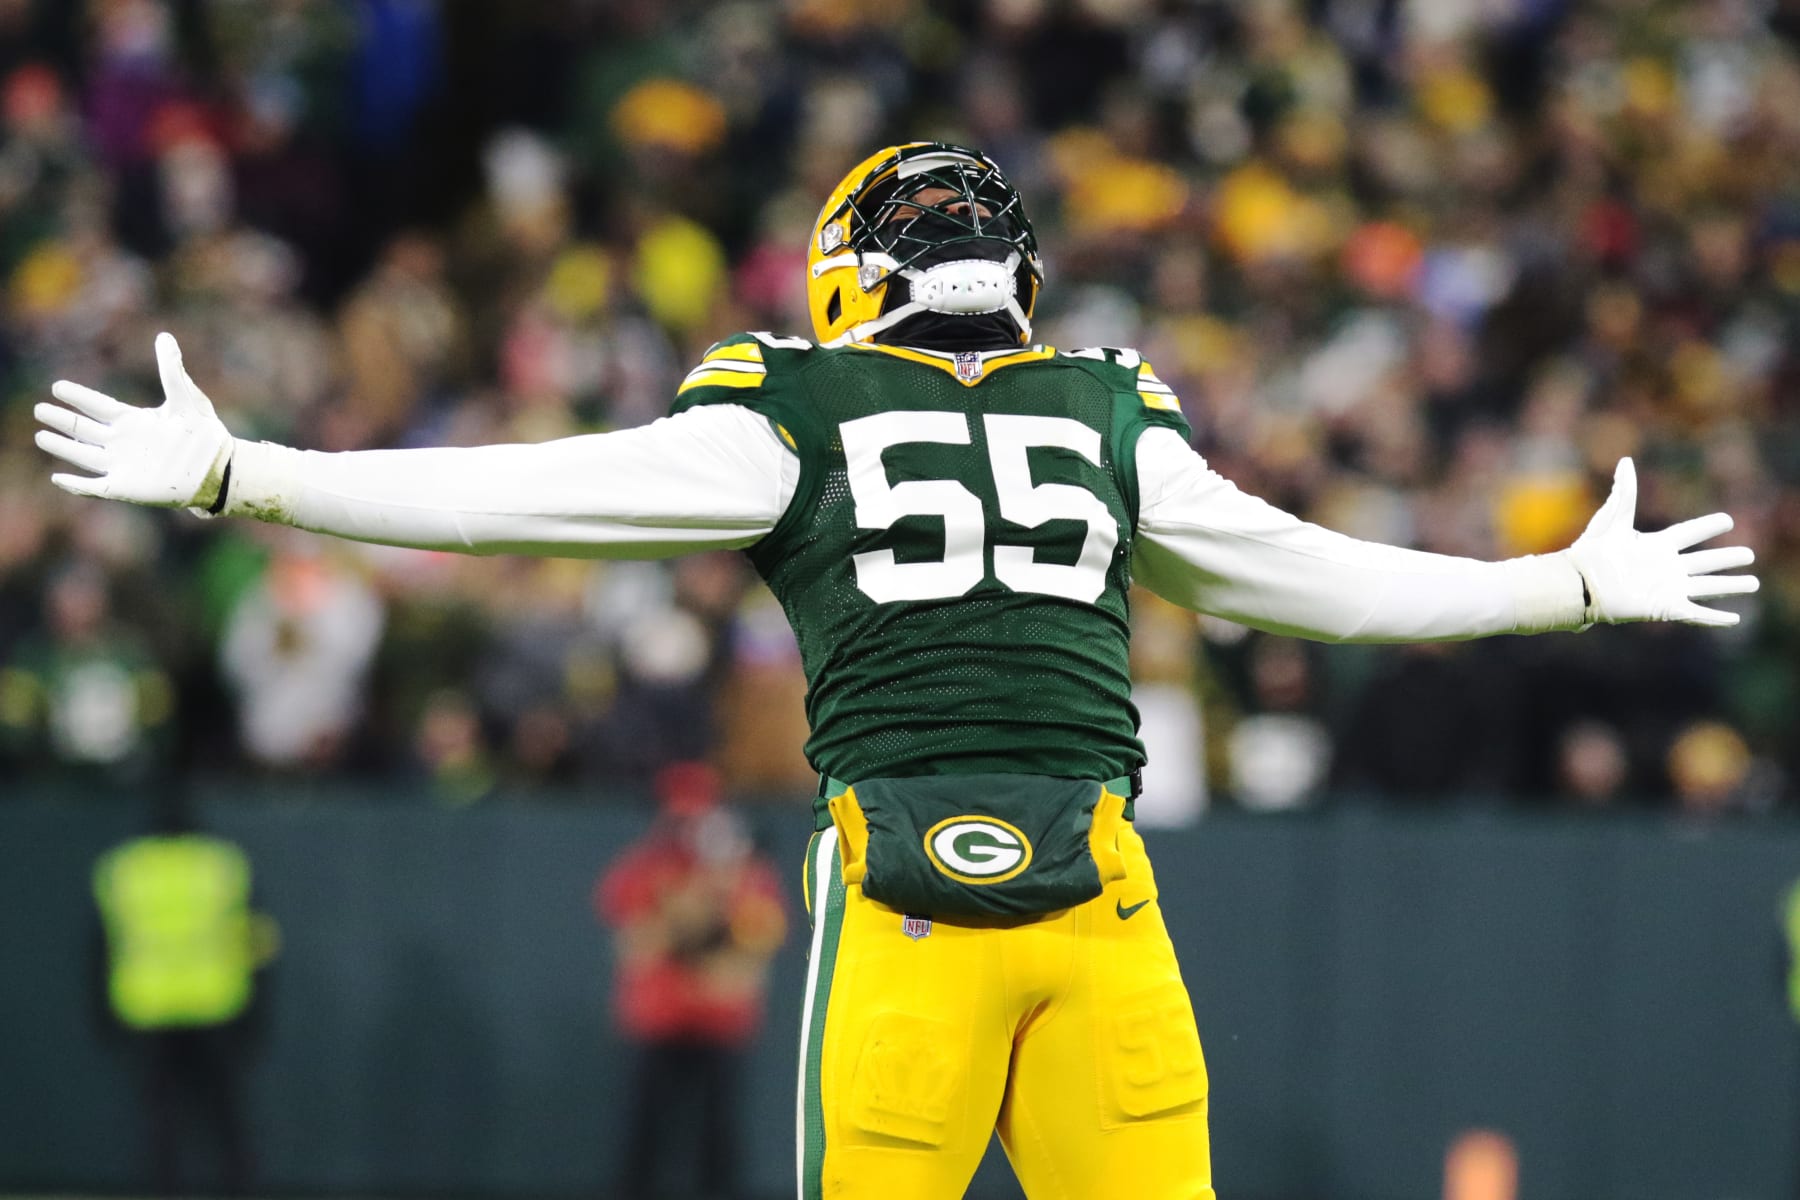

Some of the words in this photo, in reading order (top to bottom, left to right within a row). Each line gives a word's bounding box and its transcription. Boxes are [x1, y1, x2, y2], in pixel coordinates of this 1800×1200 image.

[838, 410, 1118, 604] 55
[934, 823, 1022, 874] G
[907, 920, 929, 935] NFL
